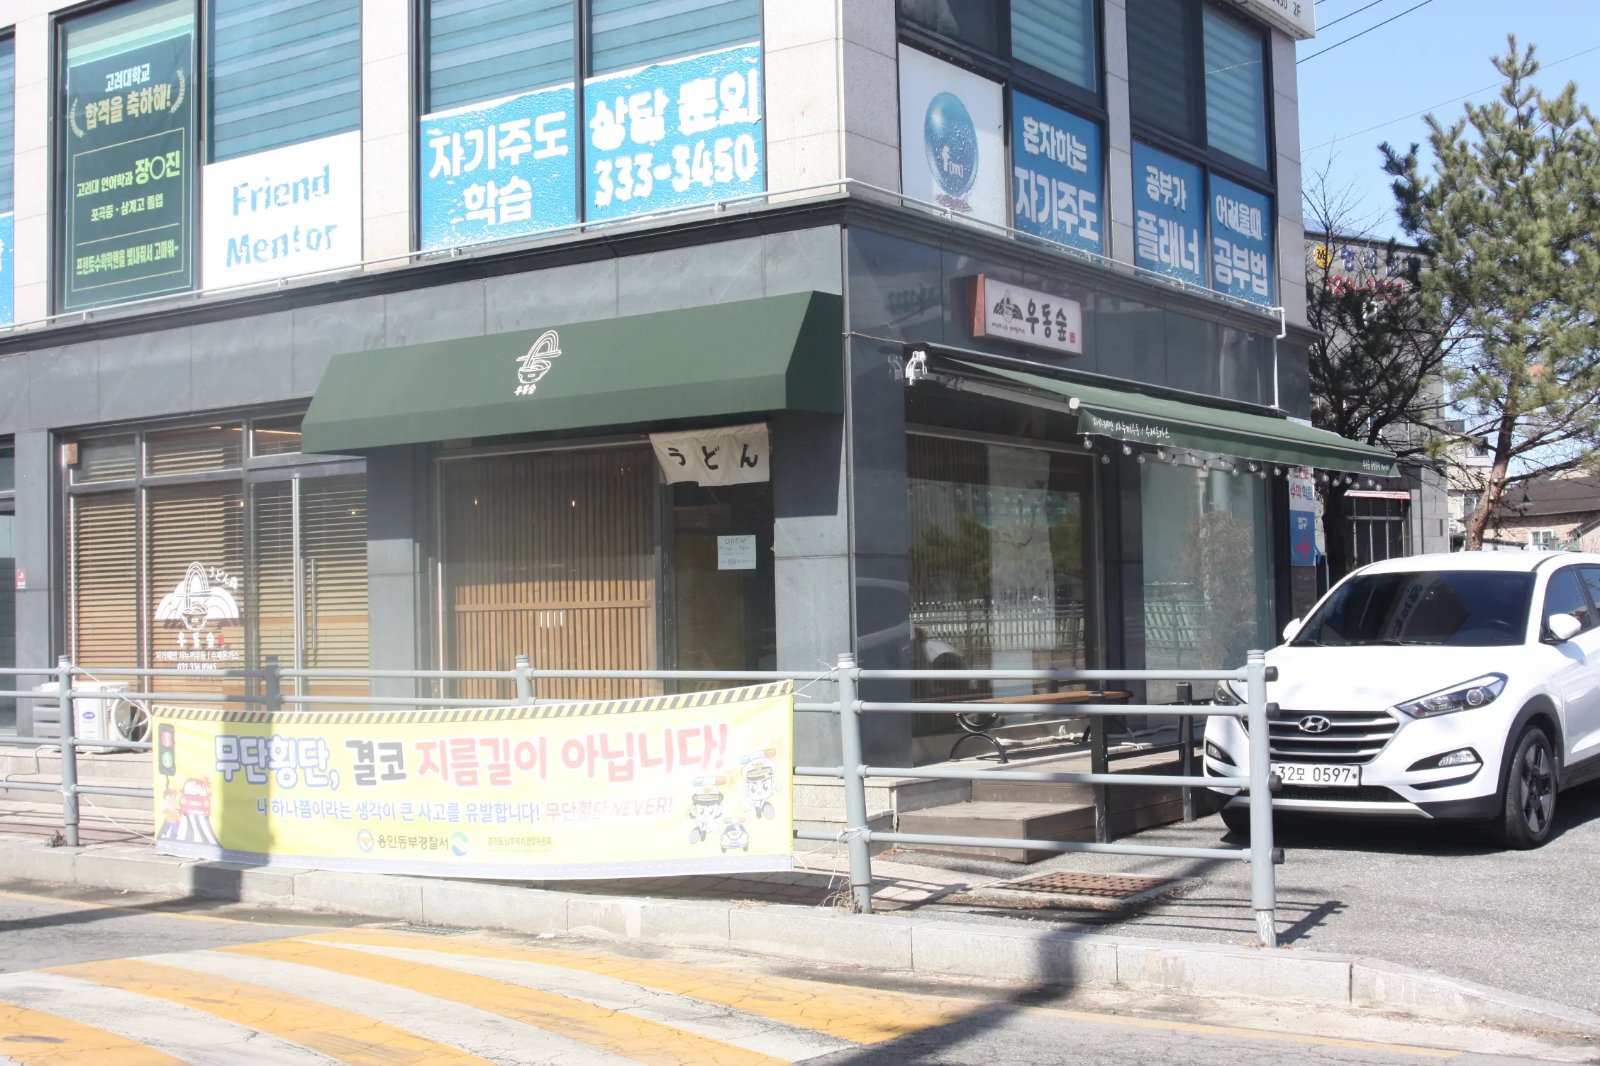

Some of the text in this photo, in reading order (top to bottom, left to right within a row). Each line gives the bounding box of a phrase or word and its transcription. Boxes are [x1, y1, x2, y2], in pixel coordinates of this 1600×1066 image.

[105, 63, 150, 92] 고려대학교
[85, 83, 171, 131] 합격을 축하해!
[589, 88, 669, 151] 상담
[1022, 115, 1088, 173] 혼자하는
[77, 179, 100, 197] 고려대
[101, 171, 133, 192] 언어학과
[232, 164, 330, 216] Friend
[594, 133, 758, 208] 333-3450
[1146, 165, 1187, 212] 공부가
[91, 193, 163, 221] 포곡중 삼계고 졸업
[463, 175, 533, 226] 학습
[1015, 166, 1098, 242] 자기주도
[1216, 194, 1263, 241] 어려울때
[225, 225, 338, 268] Mentor
[1137, 210, 1200, 274] 플래너
[1214, 237, 1268, 295] 공부법
[1025, 298, 1068, 341] 우동숲
[668, 444, 758, 470] うどん
[215, 724, 728, 790] 무단횡단, 결코 지름길이 아닙니다!
[1313, 767, 1350, 782] 0597
[257, 797, 673, 824] 나 하나쯤이라는 생각이 큰 사고를 유발합니다! 무단횡단 NEVER!
[377, 834, 449, 850] 용인동부경찰서
